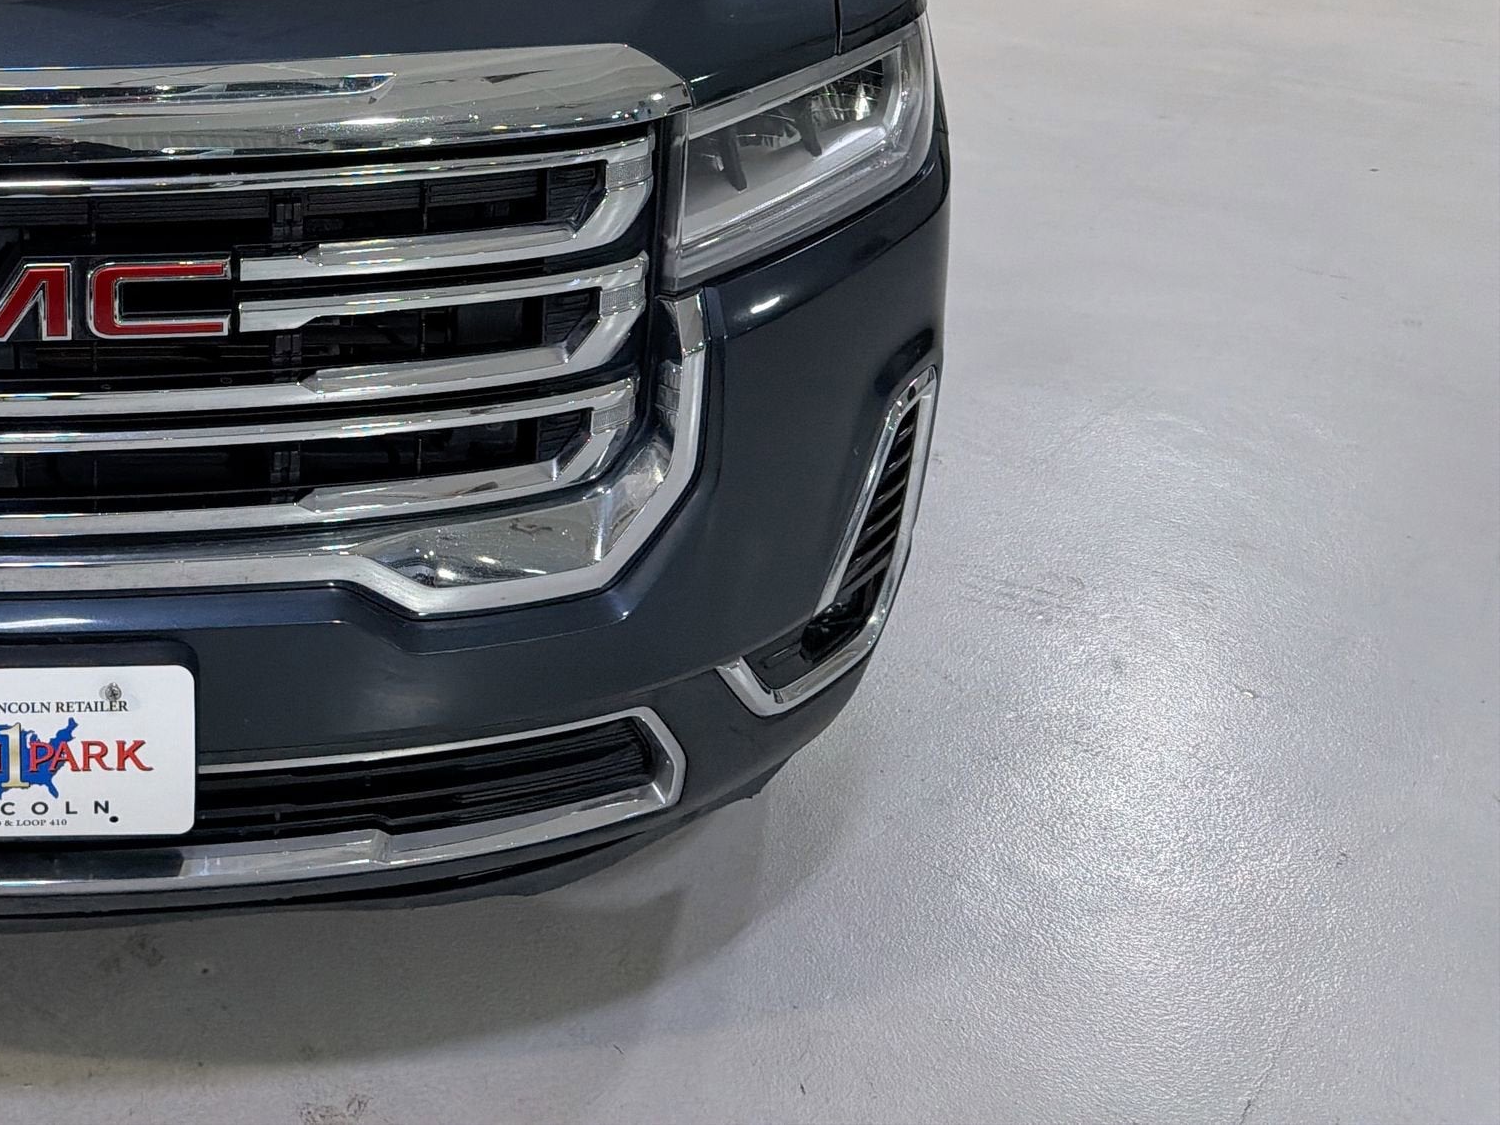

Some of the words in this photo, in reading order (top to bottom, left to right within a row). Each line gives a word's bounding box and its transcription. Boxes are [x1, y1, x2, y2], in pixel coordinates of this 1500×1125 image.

[55, 700, 128, 713] RETAILER
[27, 739, 154, 773] PARK
[4, 819, 14, 827] &
[16, 818, 46, 827] LOOP
[49, 818, 67, 826] 410
